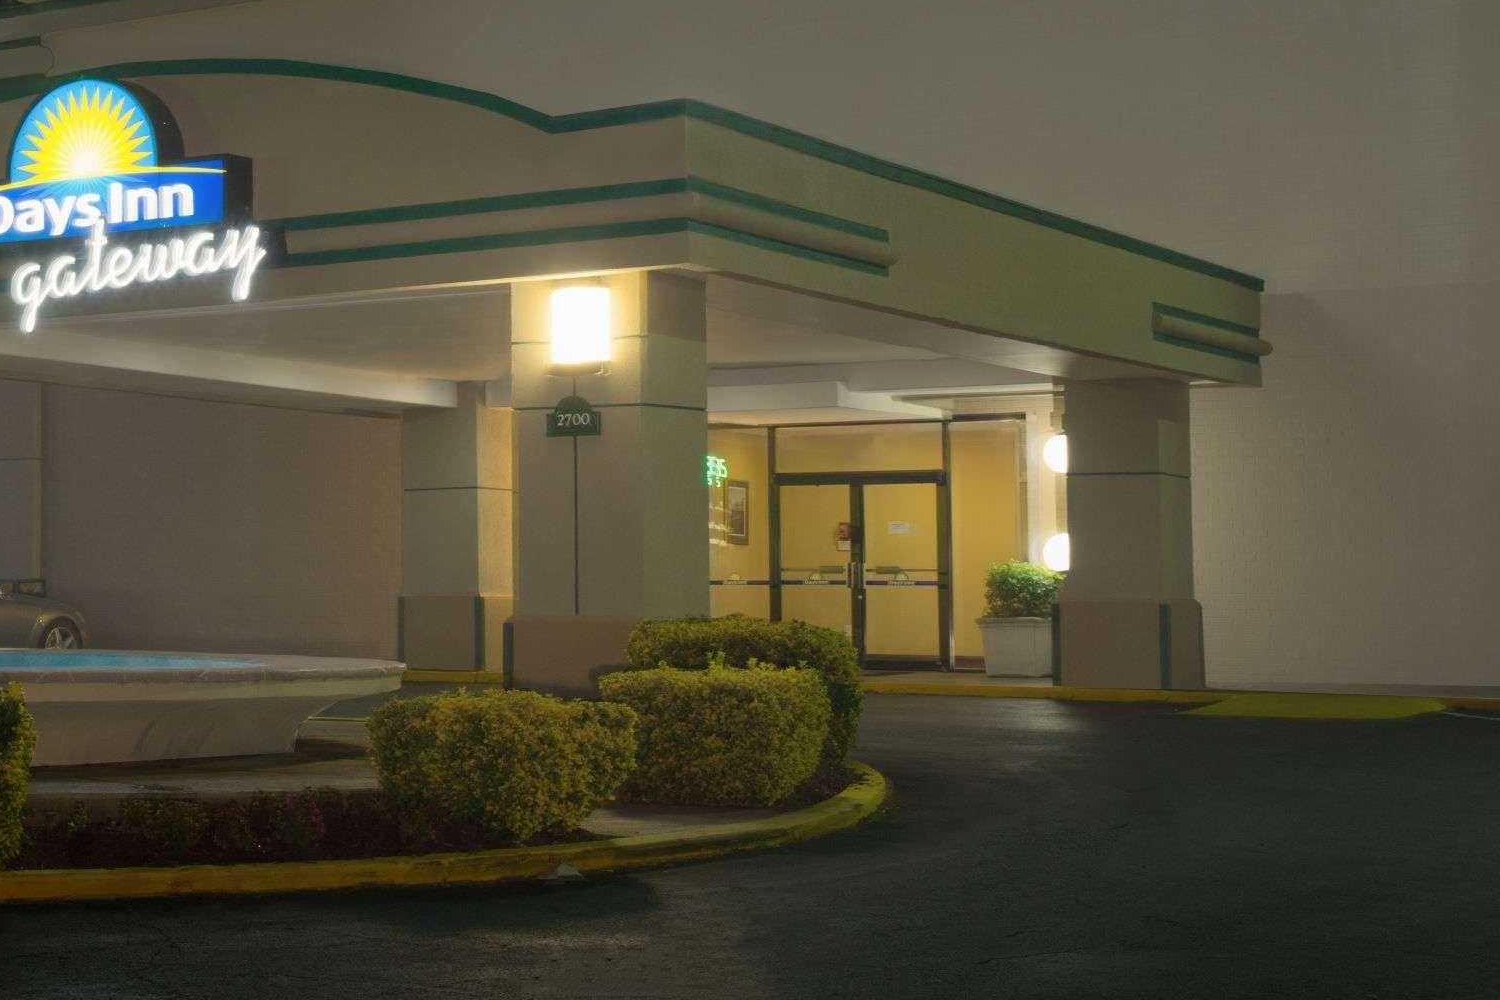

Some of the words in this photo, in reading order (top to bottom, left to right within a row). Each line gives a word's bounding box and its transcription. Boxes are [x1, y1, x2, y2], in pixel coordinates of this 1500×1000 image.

[107, 182, 194, 224] Inn
[10, 216, 266, 333] gateway
[557, 412, 590, 426] 2700
